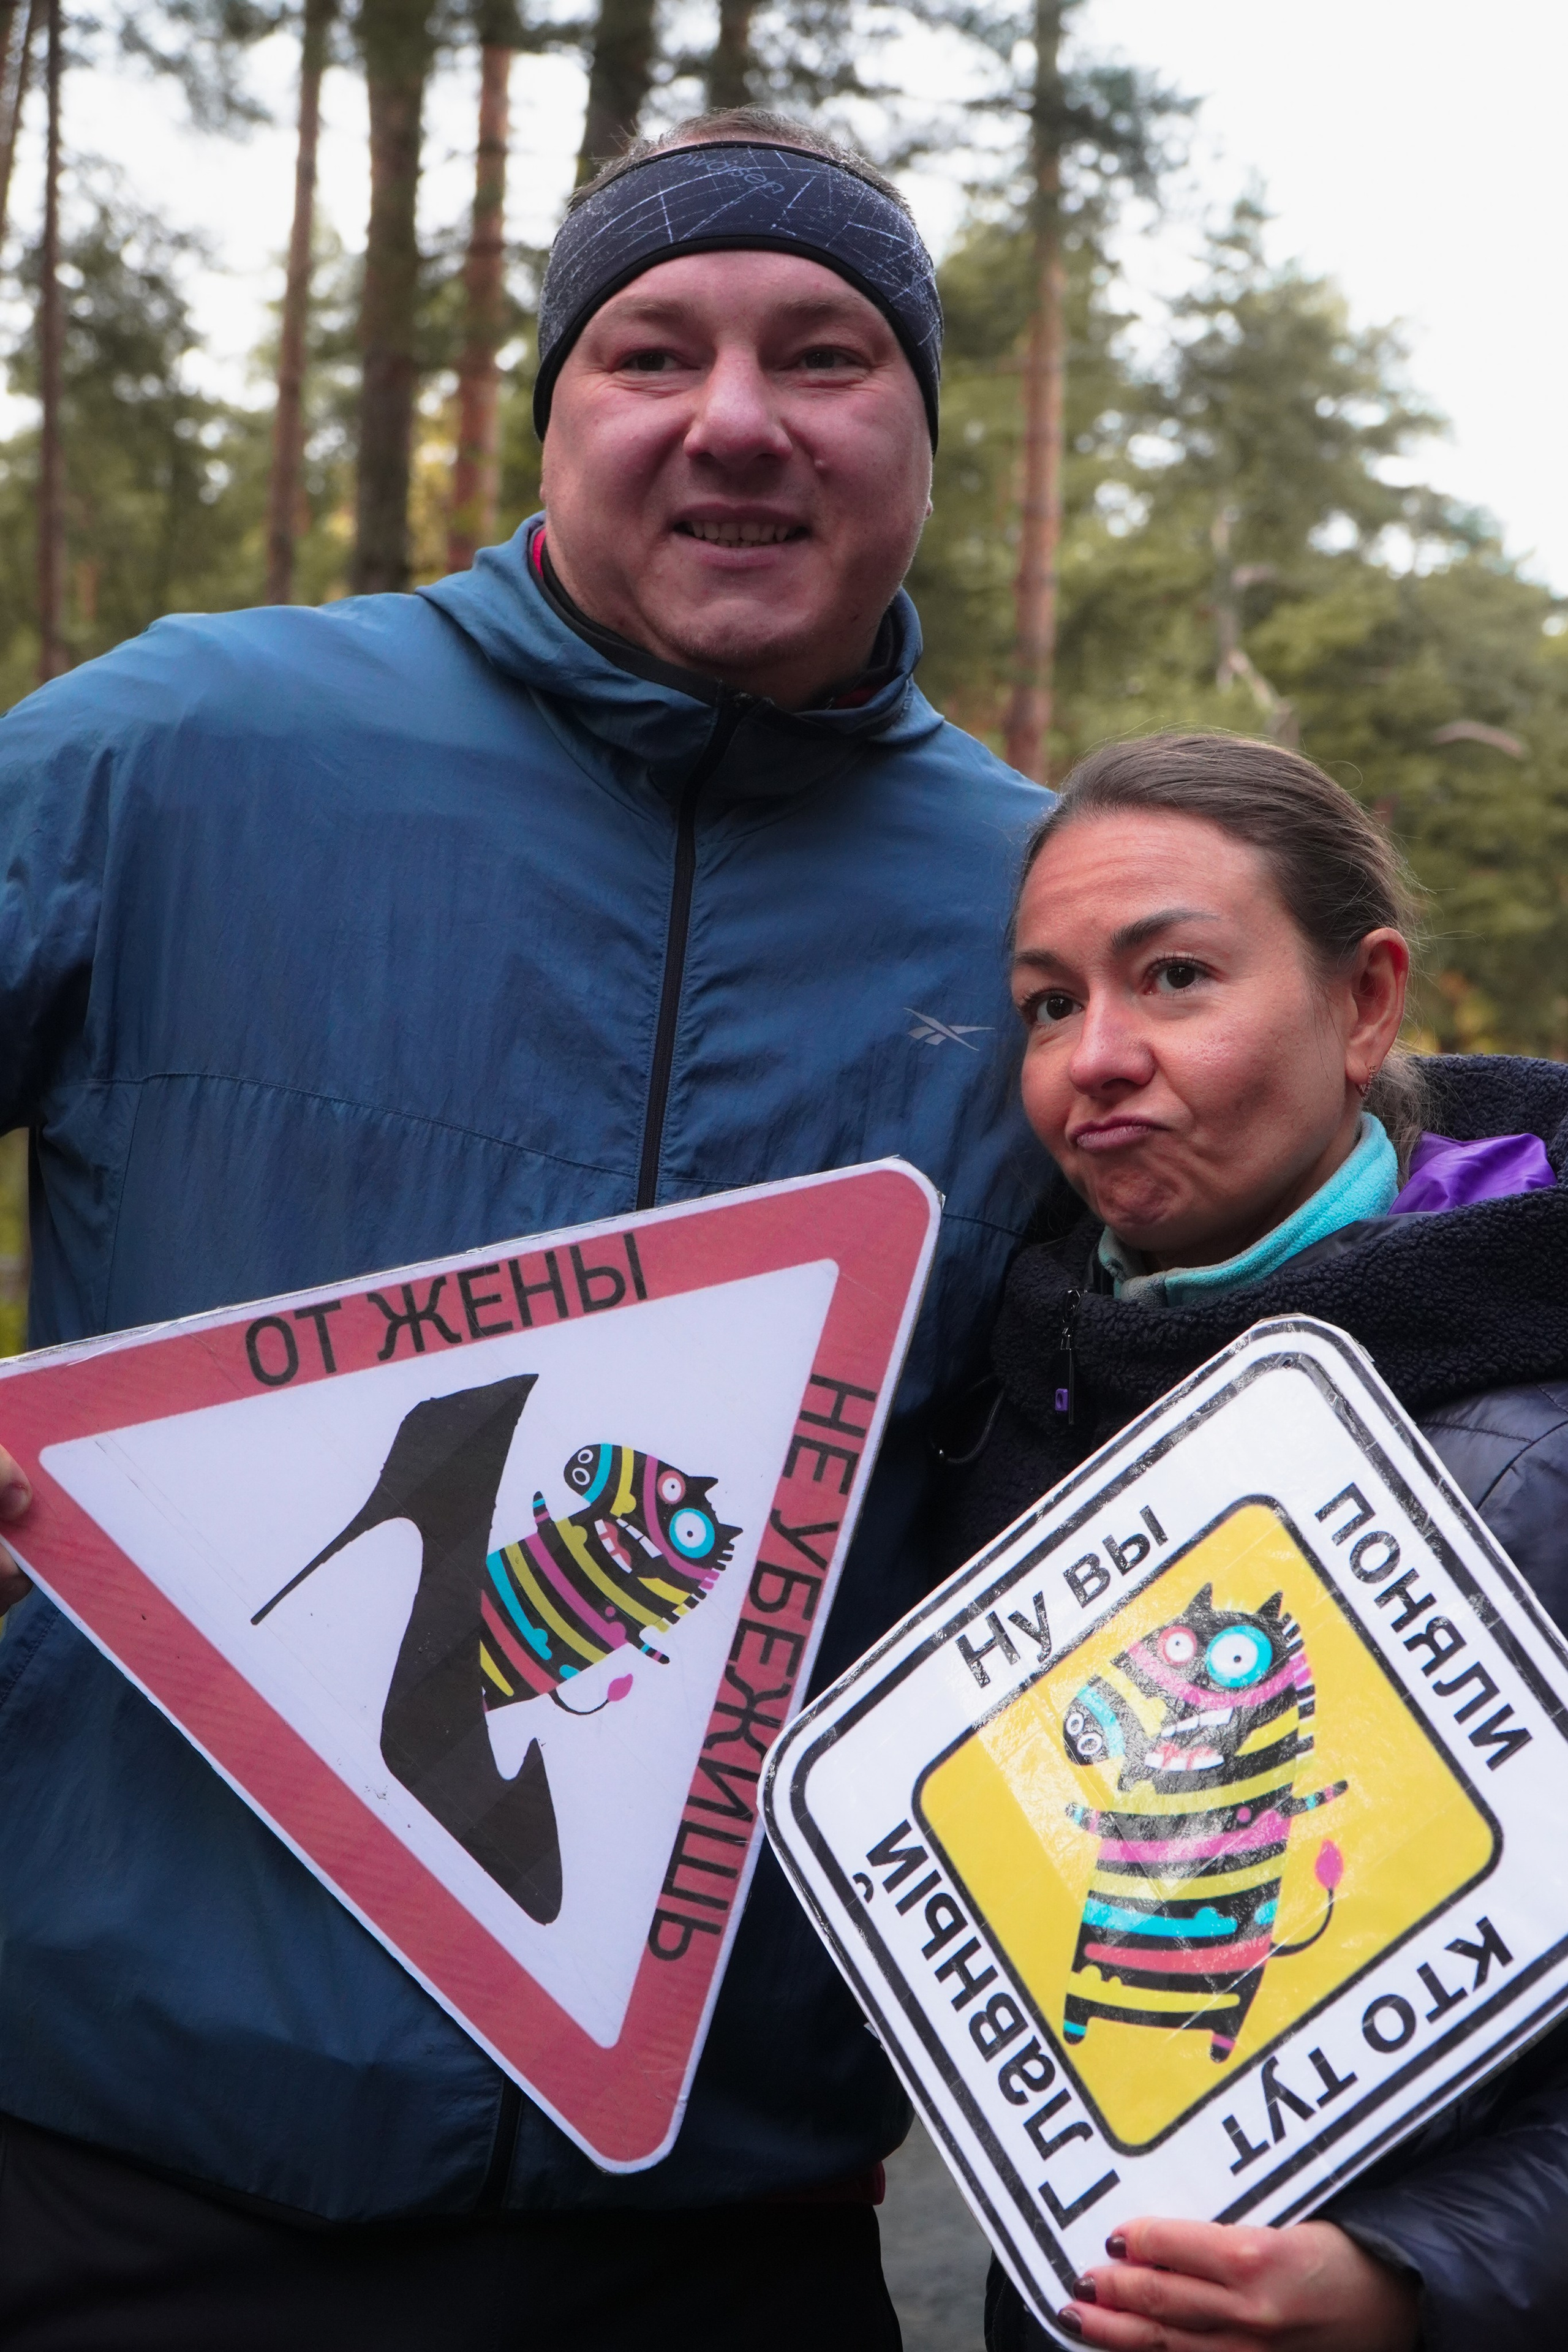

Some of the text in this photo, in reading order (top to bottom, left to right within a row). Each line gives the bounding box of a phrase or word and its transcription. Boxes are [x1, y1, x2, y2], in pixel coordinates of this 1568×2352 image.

[245, 1231, 647, 1387] ОТ ЖЕНЫ
[648, 1373, 877, 1961] НЕ УБЕЖИШЬ
[954, 1504, 1169, 1689] Ну вы
[1313, 1482, 1533, 1773] поняли
[851, 1819, 1121, 2231] Главный
[1220, 1915, 1514, 2176] кто тут
